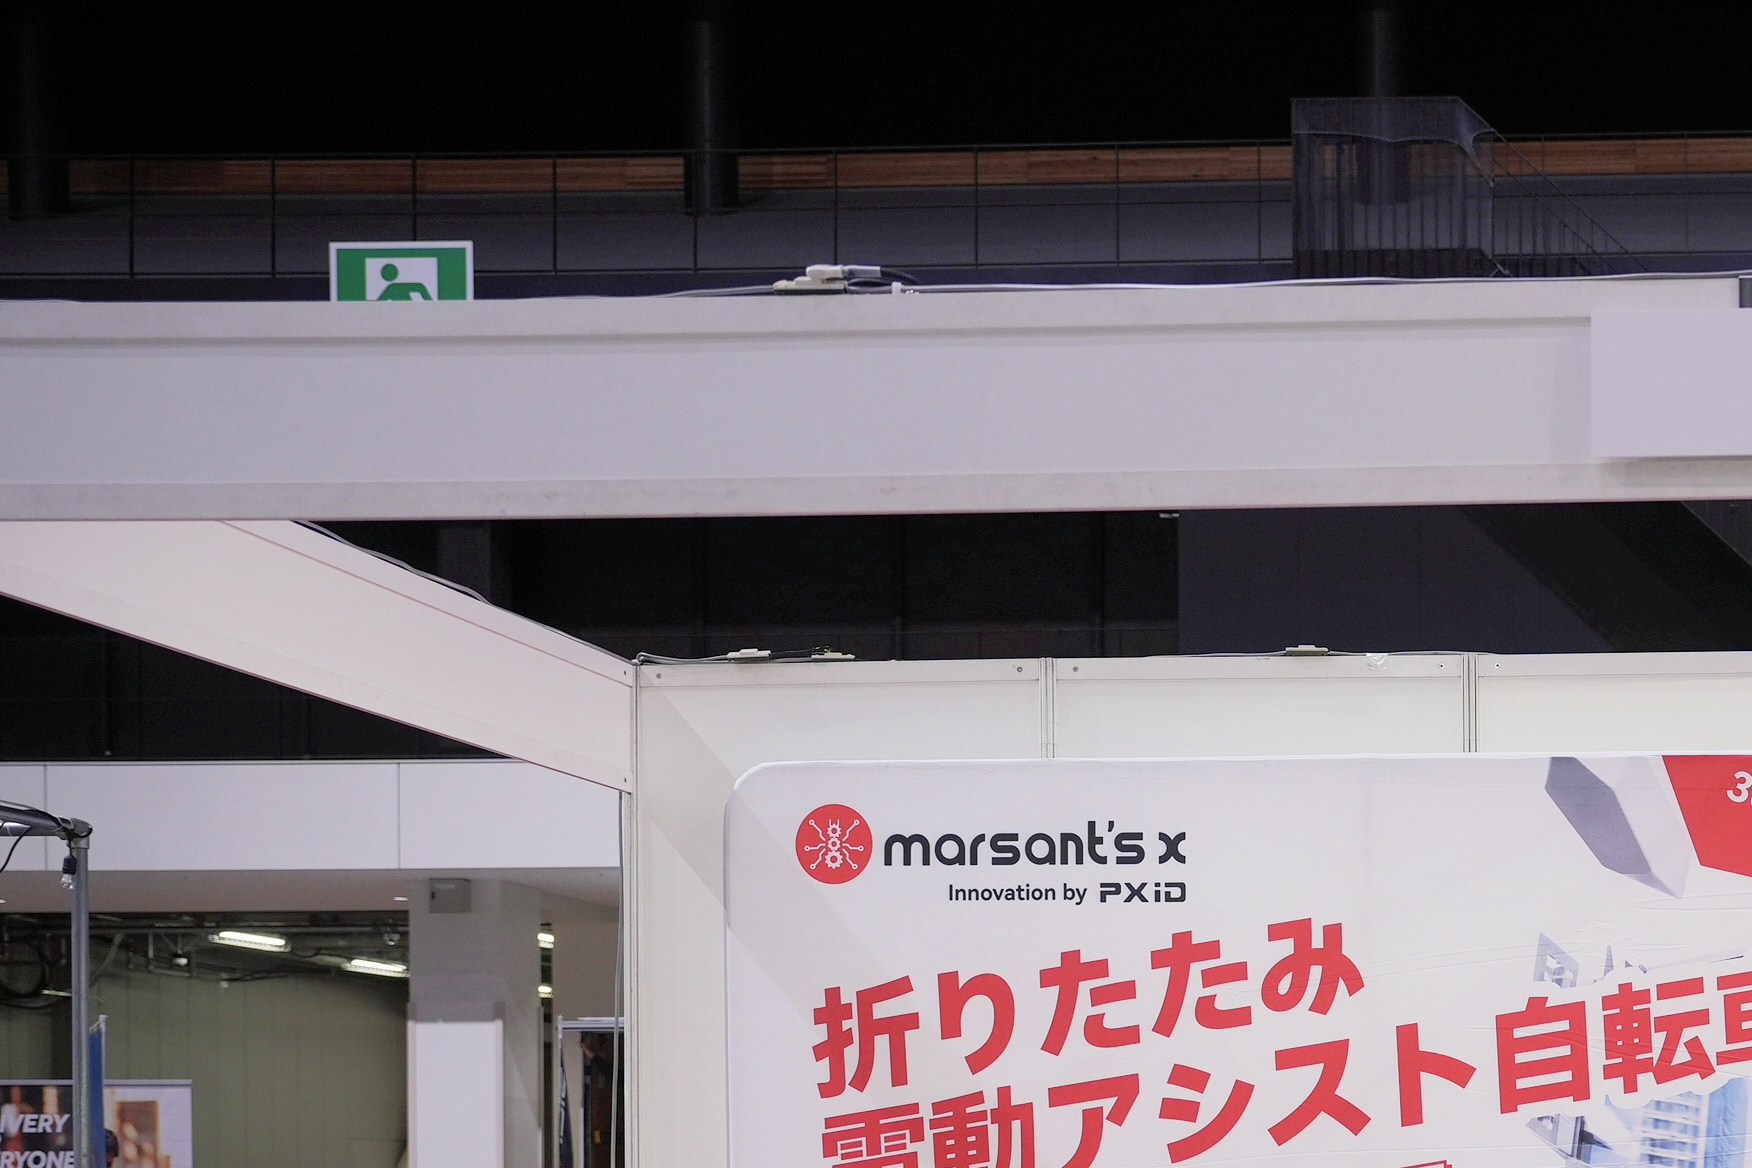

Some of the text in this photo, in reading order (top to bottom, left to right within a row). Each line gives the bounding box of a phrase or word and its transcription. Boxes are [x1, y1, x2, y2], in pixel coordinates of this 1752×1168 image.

[883, 820, 1146, 867] marsant's
[948, 882, 1057, 902] Innovation
[1062, 882, 1089, 906] by
[812, 917, 1365, 1099] 折りたたみ
